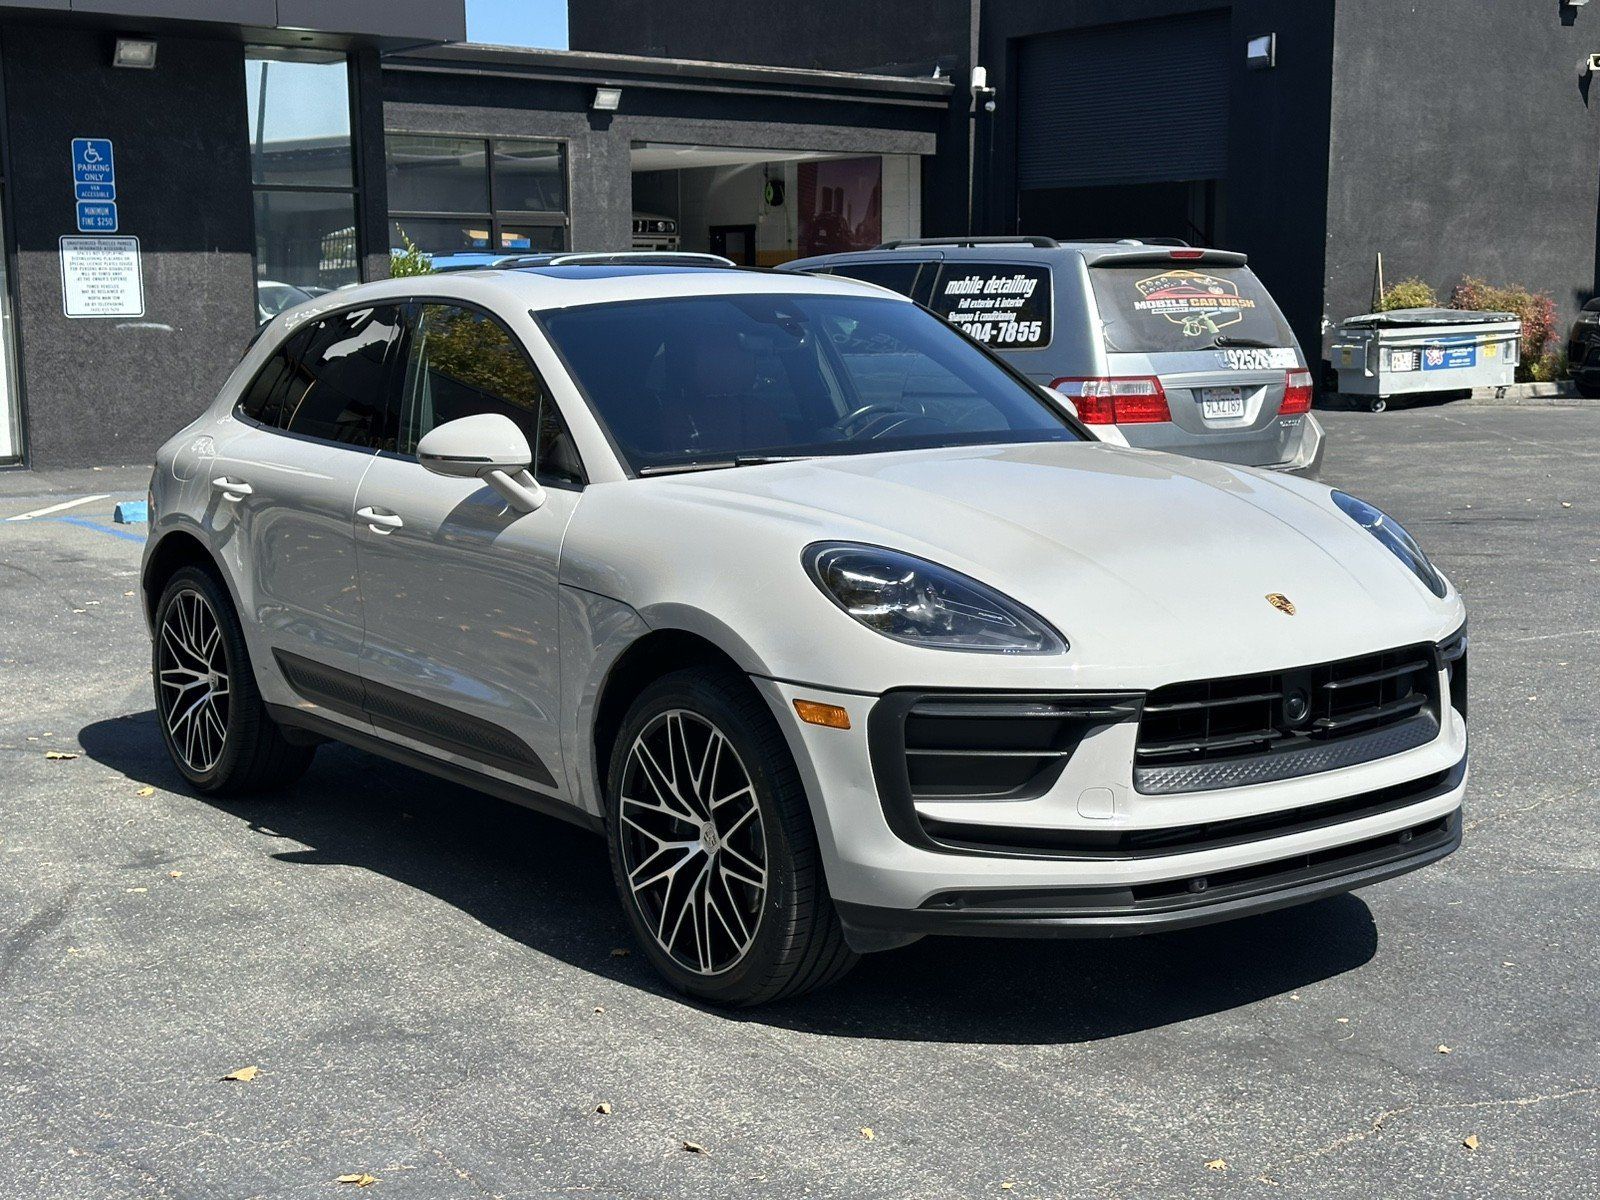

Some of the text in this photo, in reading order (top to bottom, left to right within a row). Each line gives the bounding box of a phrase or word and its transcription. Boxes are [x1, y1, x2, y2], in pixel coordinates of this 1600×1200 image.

[77, 164, 110, 172] PARKING
[85, 173, 103, 181] ONLY
[85, 206, 109, 215] MINIMUM
[82, 217, 113, 226] FINE $250
[944, 274, 1038, 298] mobile detailing
[958, 297, 1025, 308] Full exterior & interior
[1134, 298, 1255, 310] MOBILE CAR WASH
[948, 310, 1016, 323] Shampoo & conditioning
